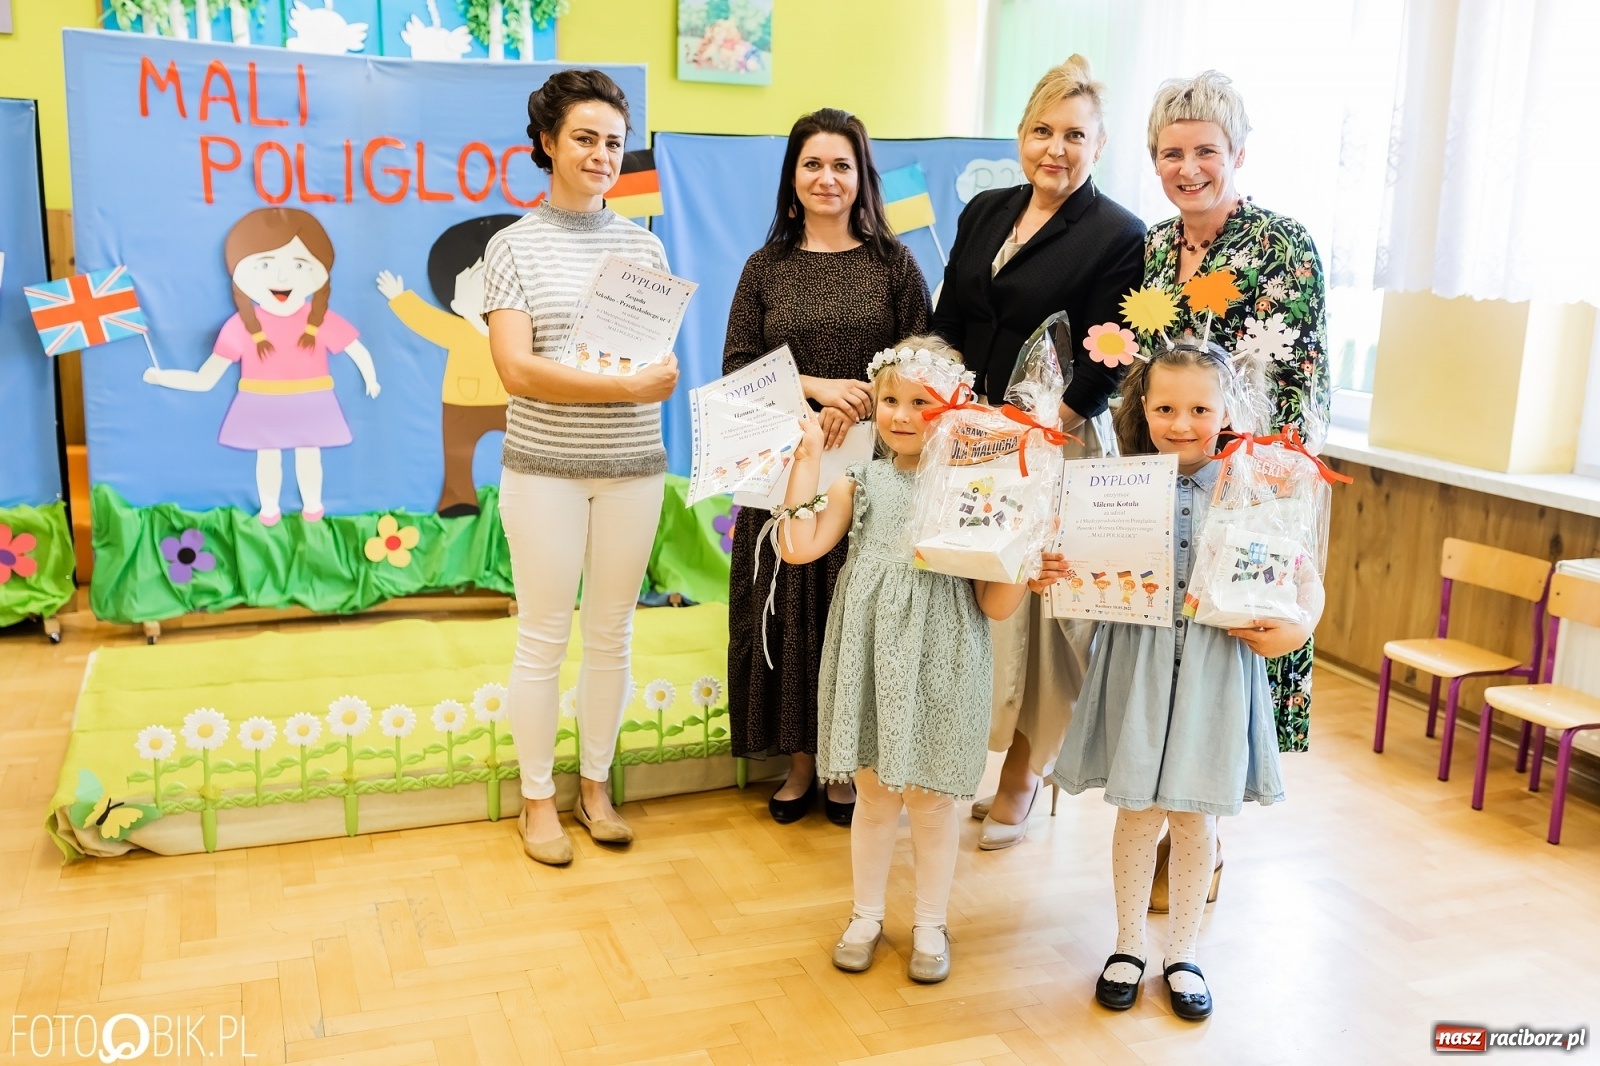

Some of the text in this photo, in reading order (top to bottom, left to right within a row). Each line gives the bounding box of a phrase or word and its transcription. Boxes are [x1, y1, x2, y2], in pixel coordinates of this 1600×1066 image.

[138, 55, 309, 127] MALI
[198, 135, 550, 209] POLIGLOC
[621, 271, 672, 297] DYPLOM
[595, 290, 616, 303] Szkolno
[619, 300, 660, 320] Przedszkolnego
[725, 372, 777, 403] DYPLOM
[970, 436, 1018, 458] MALUCHA
[1089, 473, 1151, 487] DYPLOM
